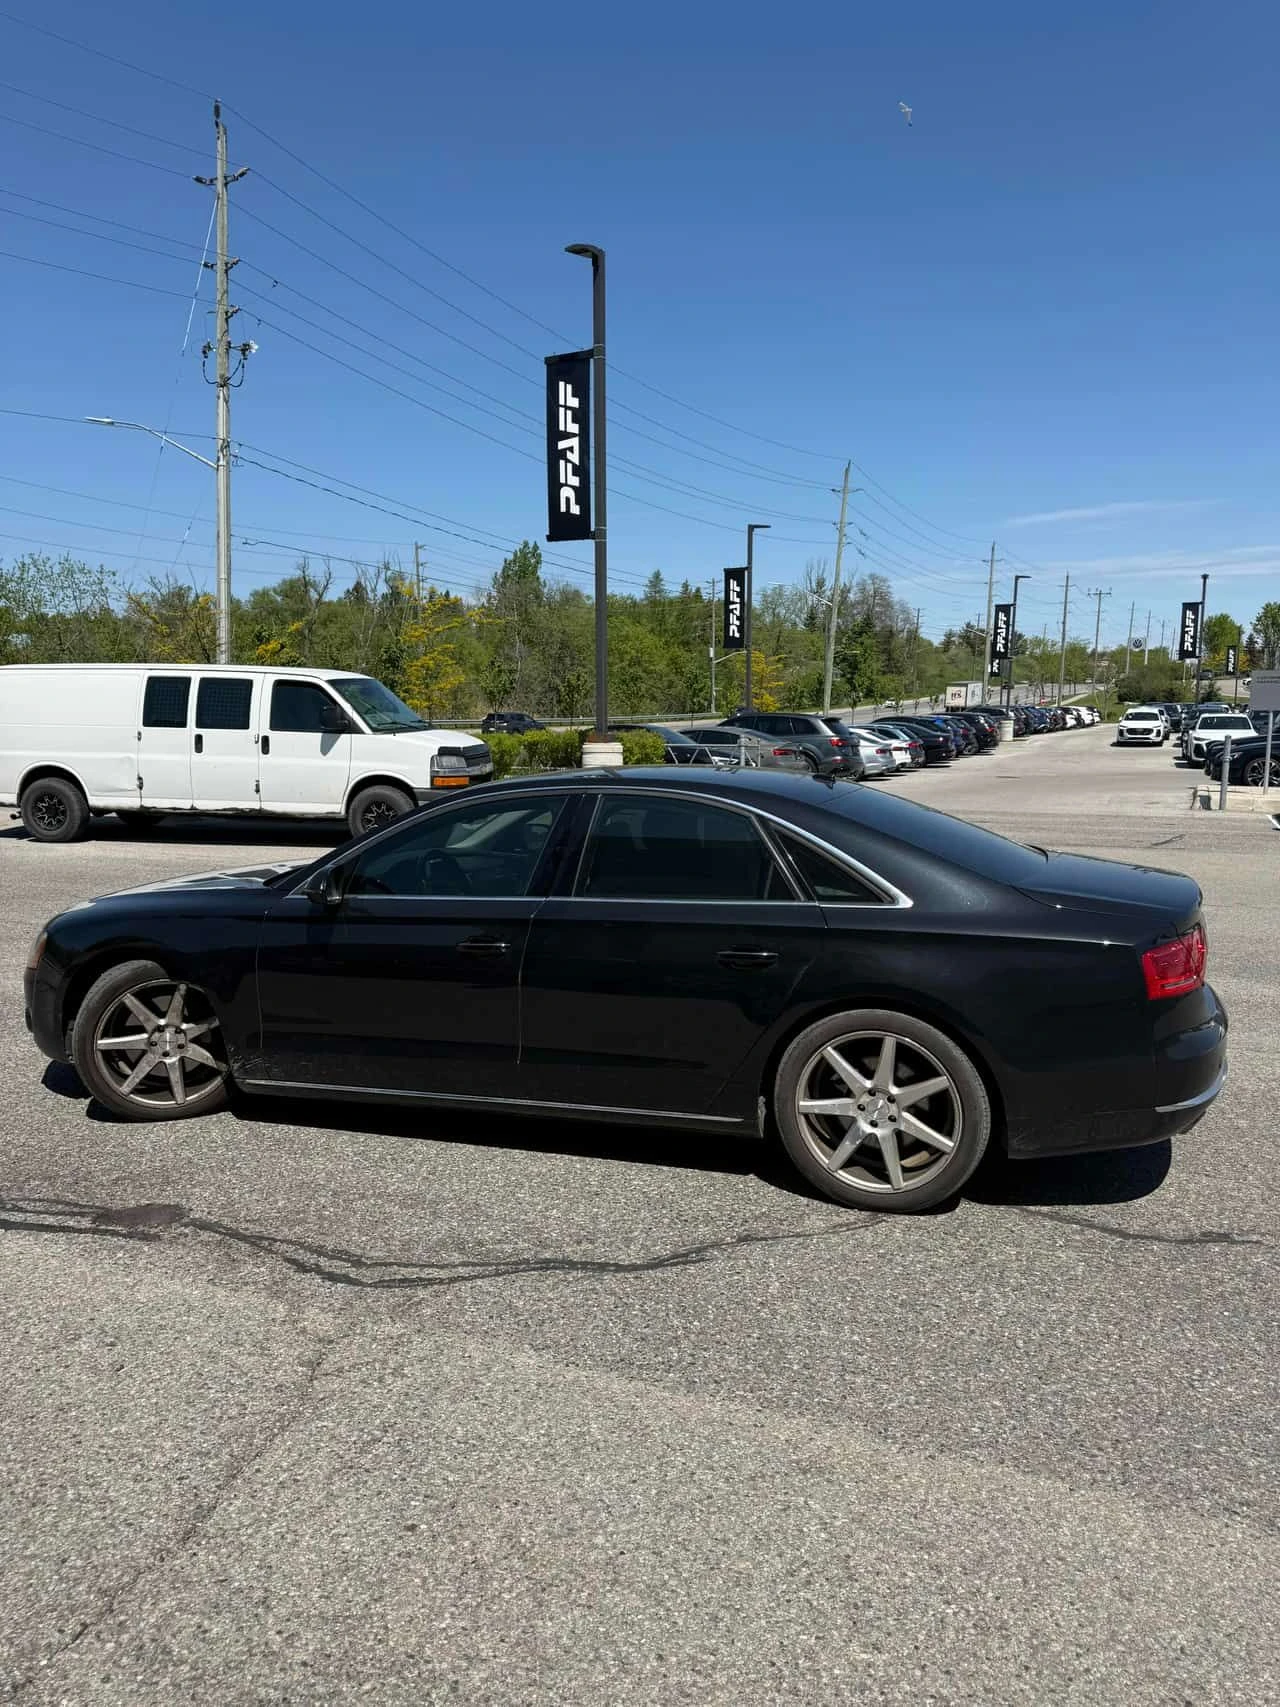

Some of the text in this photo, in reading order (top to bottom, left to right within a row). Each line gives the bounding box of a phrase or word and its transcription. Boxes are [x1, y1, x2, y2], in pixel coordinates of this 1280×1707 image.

[557, 381, 580, 515] PFAFF
[729, 578, 740, 638] PFAFF
[997, 611, 1007, 653] PFAFF
[1184, 609, 1195, 652] PFAFF
